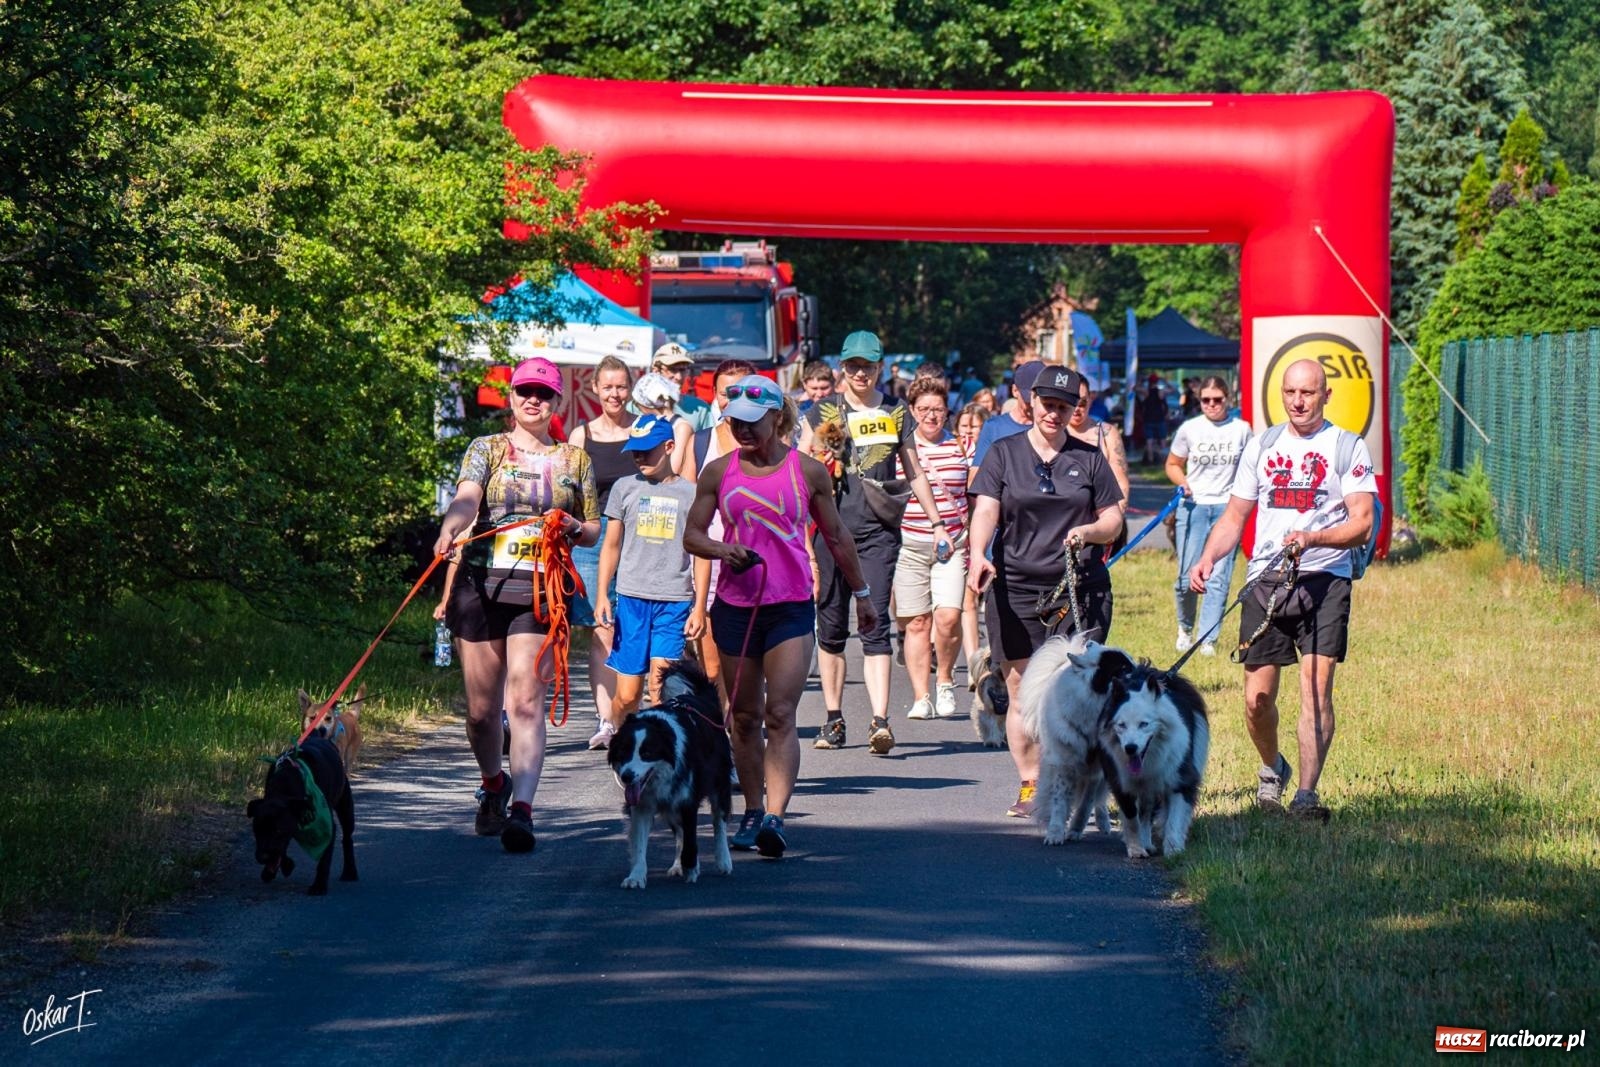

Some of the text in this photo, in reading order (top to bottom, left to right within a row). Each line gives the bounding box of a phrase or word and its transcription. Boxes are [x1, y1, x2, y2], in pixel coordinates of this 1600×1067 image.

[859, 421, 887, 435] 024
[1197, 441, 1234, 453] CAFÉ
[1273, 489, 1316, 508] BASE
[638, 514, 674, 530] GAME
